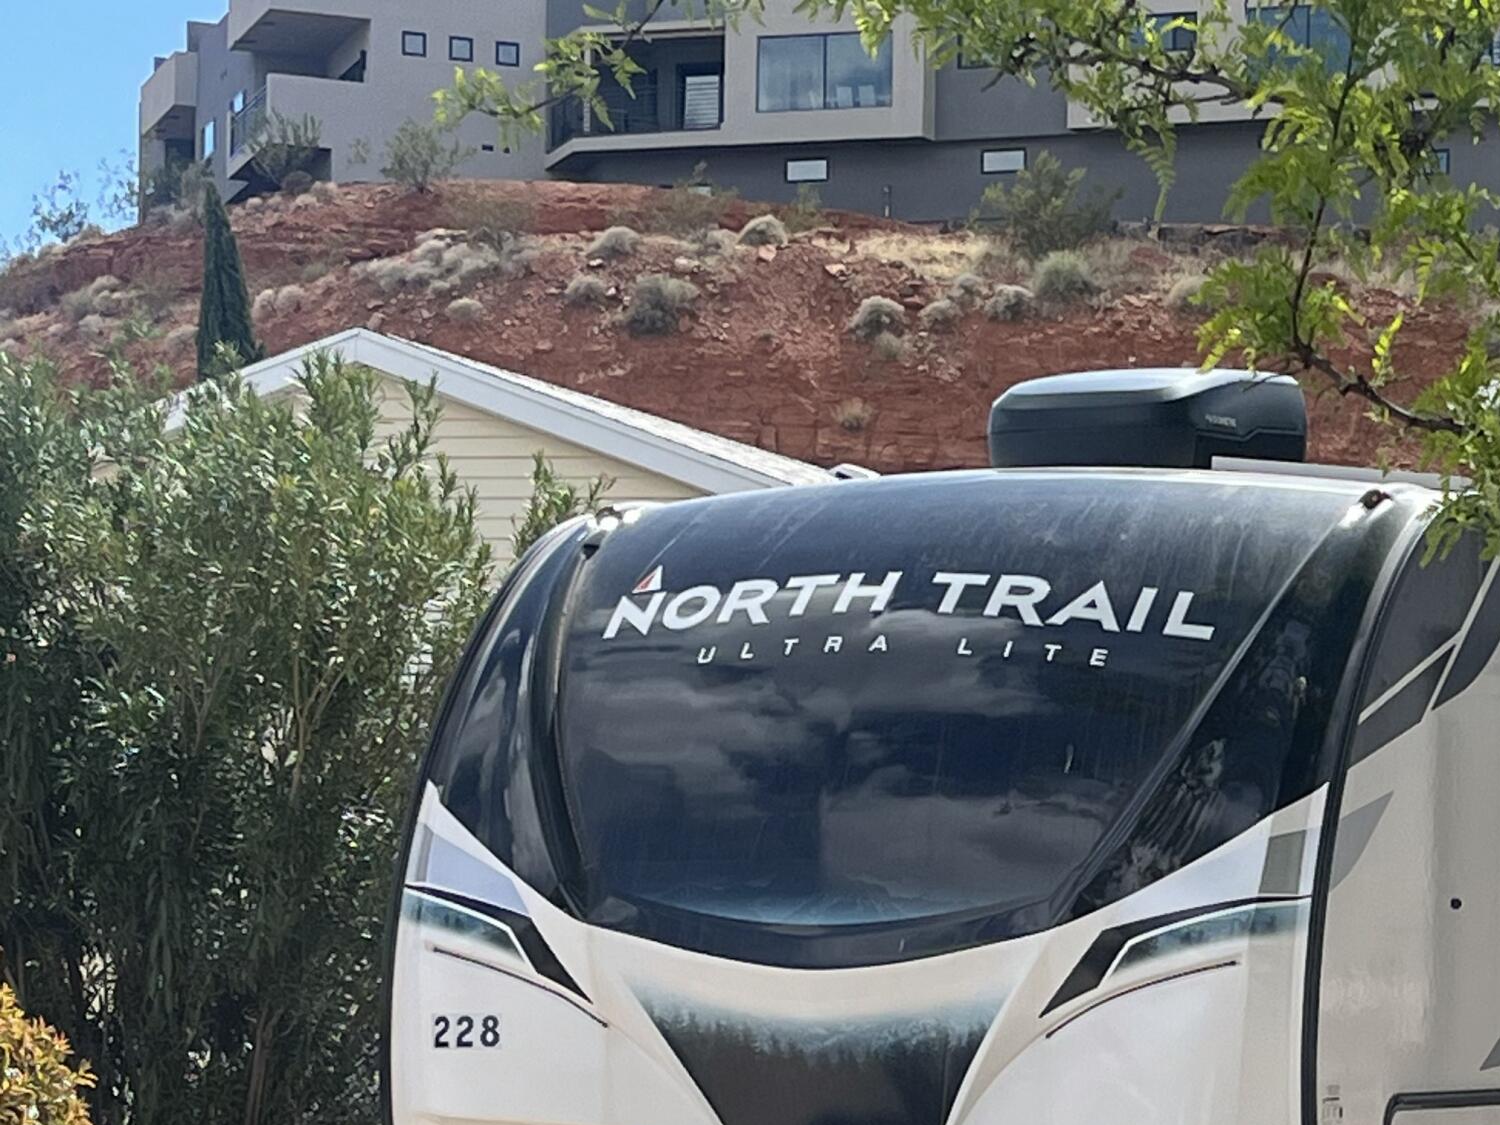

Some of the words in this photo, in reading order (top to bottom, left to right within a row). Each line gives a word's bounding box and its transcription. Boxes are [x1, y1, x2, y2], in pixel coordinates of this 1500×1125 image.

[602, 570, 903, 640] NORTH
[931, 571, 1216, 641] TRAIL
[697, 635, 889, 664] ULTRA
[957, 638, 1109, 667] LITE
[434, 1015, 500, 1048] 228
